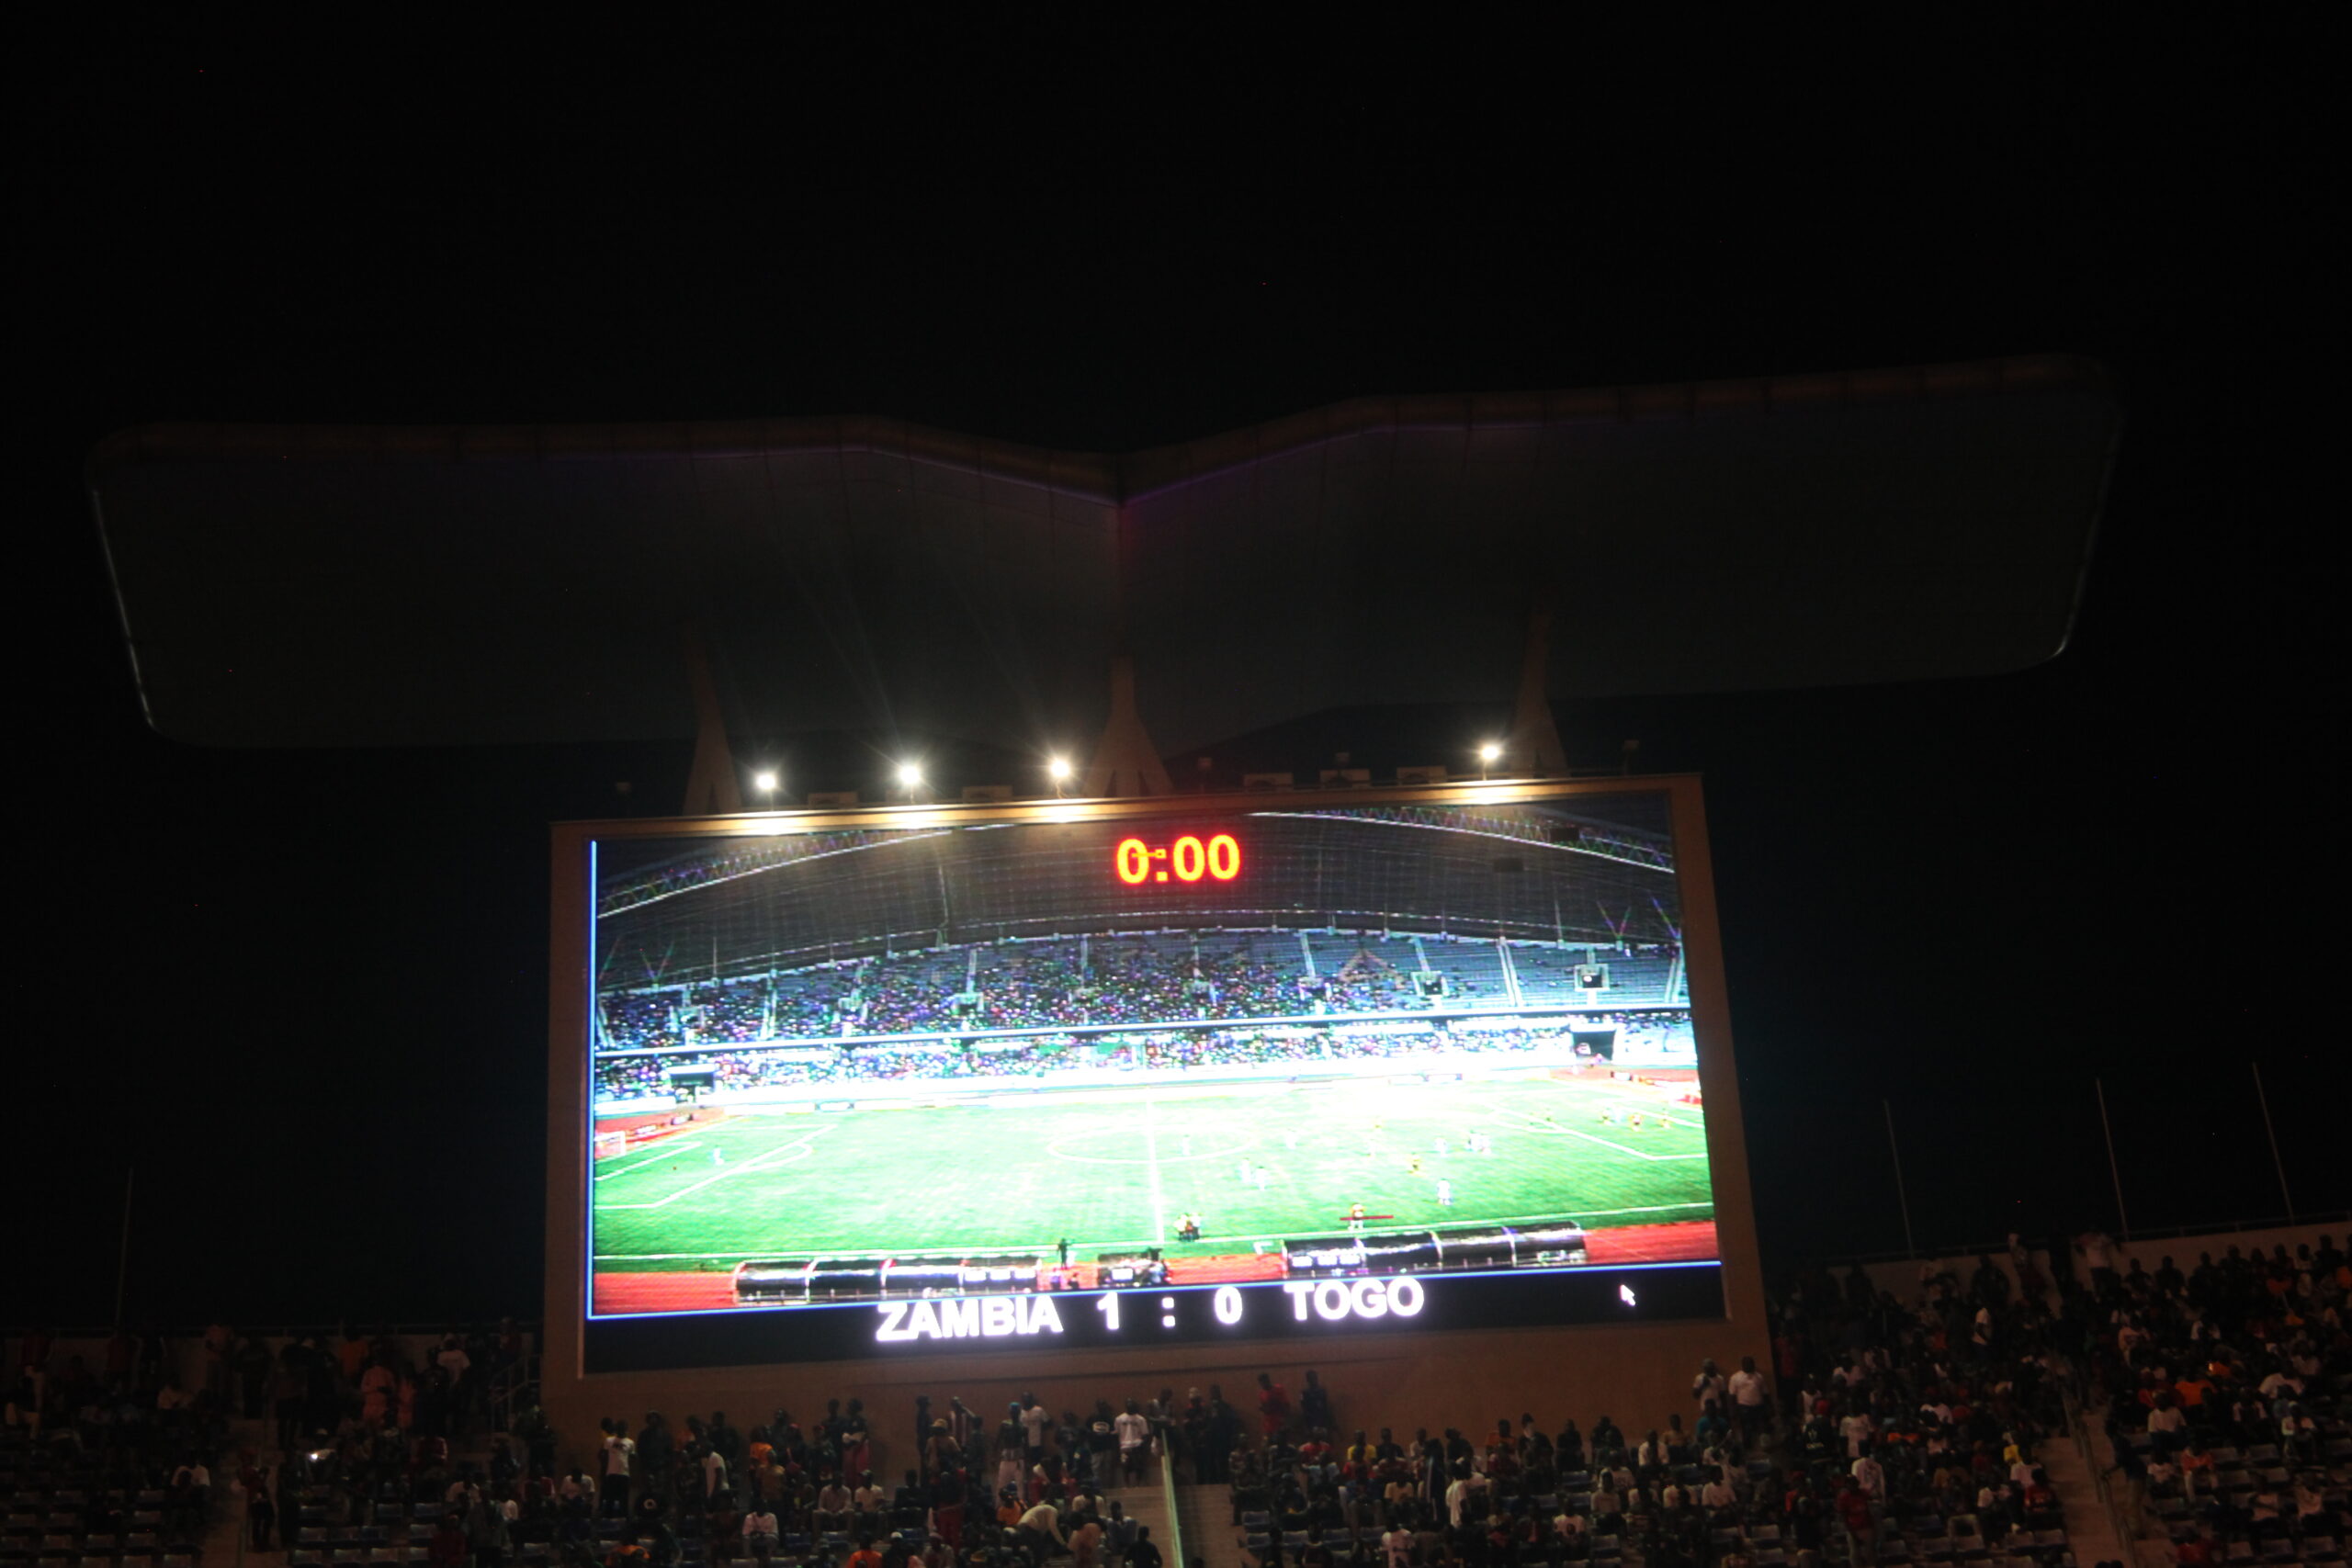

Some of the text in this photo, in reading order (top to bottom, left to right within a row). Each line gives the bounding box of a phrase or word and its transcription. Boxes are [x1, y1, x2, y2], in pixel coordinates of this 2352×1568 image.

[1115, 834, 1240, 884] 0:00
[876, 1294, 1064, 1342] ZAMBIA
[1096, 1291, 1120, 1330] 1
[1214, 1285, 1243, 1325] 0
[1283, 1276, 1425, 1321] TOGO
